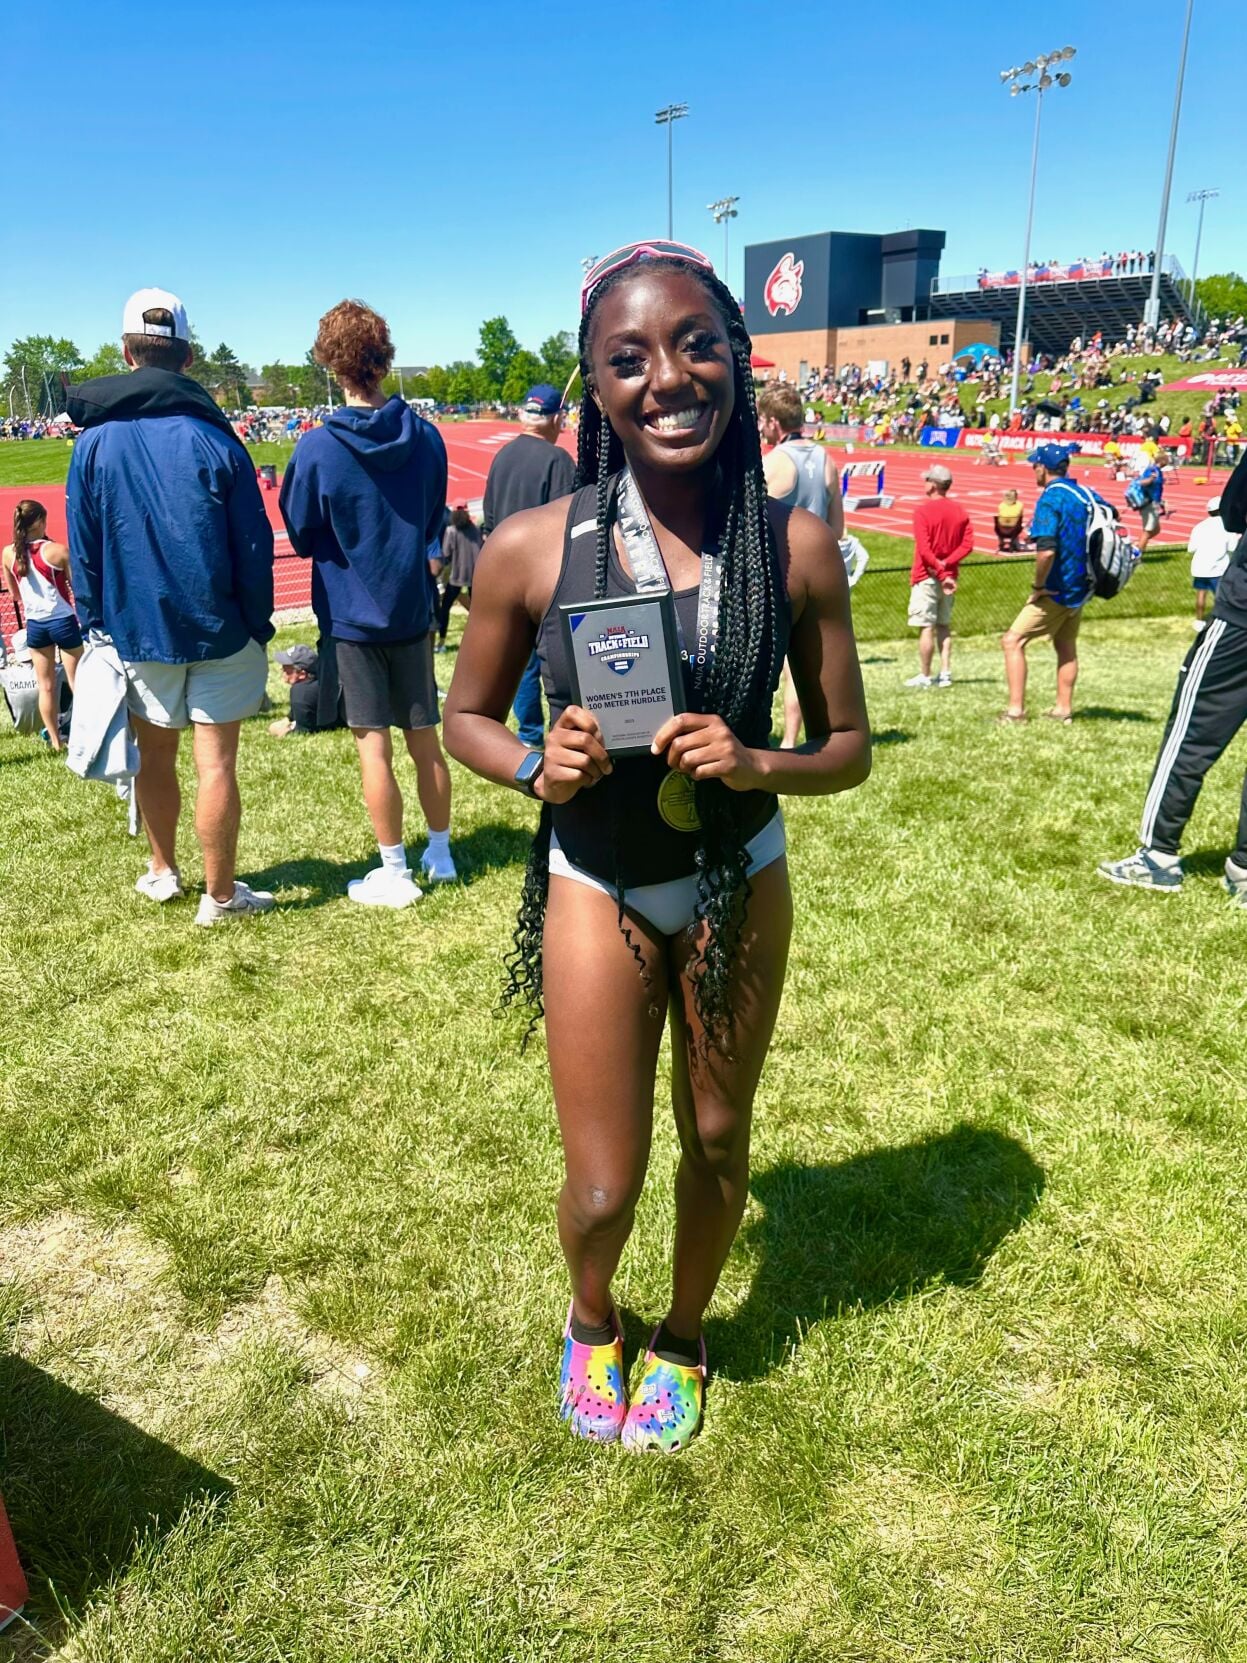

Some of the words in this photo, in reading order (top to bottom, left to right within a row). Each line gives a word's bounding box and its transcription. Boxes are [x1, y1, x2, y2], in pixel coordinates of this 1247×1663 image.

[703, 554, 714, 577] FIELD
[701, 584, 712, 613] TRACK
[588, 639, 619, 655] TRACK
[622, 635, 649, 648] FIELD
[697, 614, 709, 664] OUTDOOR
[586, 692, 623, 702] WOMEN'S
[624, 690, 639, 698] 7TH
[641, 687, 666, 696] PLACE
[604, 699, 630, 709] METER
[631, 695, 667, 705] HURDLES
